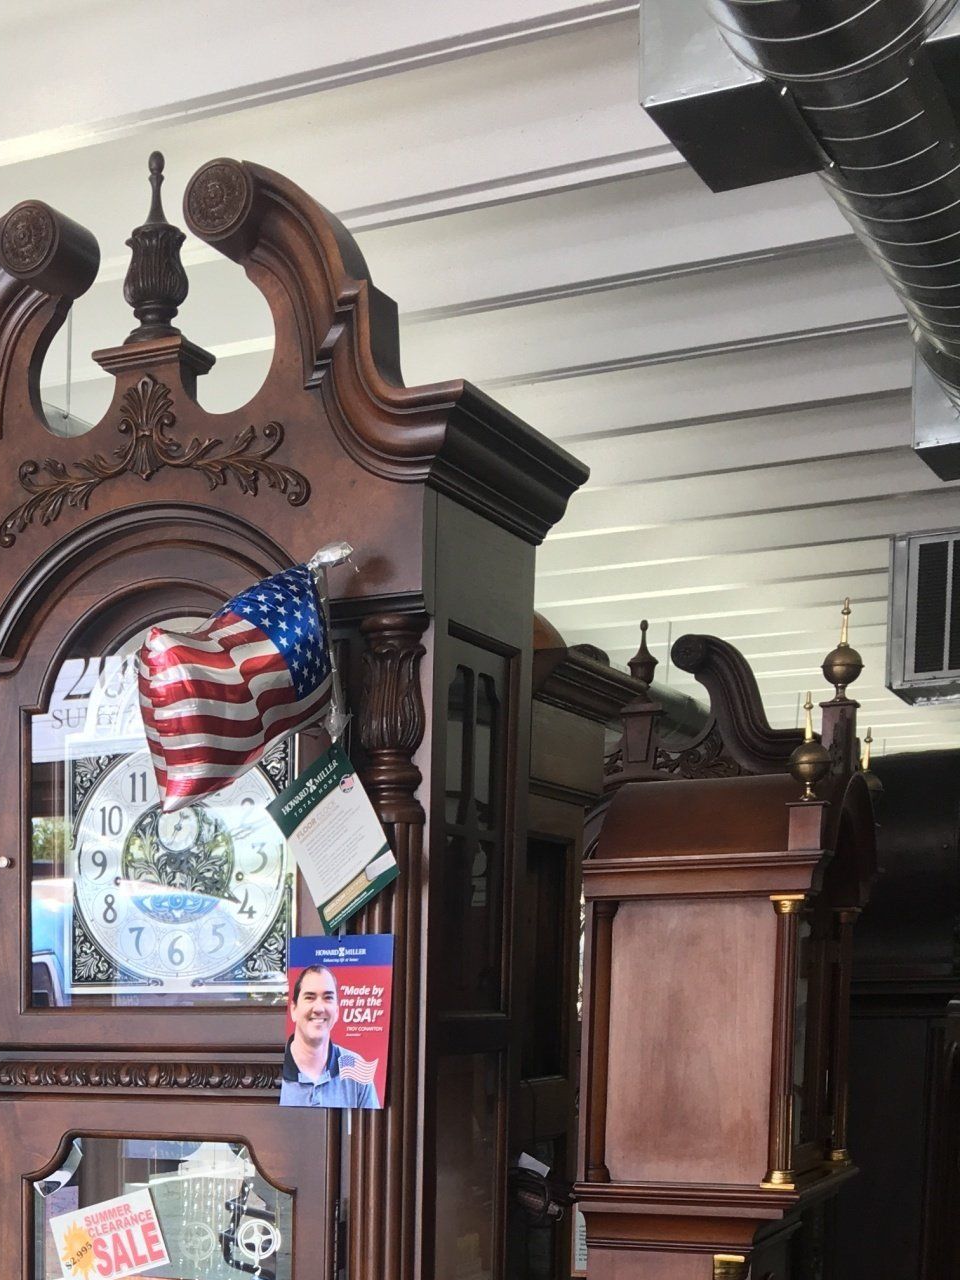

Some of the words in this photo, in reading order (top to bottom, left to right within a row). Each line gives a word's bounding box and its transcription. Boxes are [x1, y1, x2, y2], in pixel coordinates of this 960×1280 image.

[129, 771, 148, 801] 11
[281, 788, 310, 815] HOWARD
[314, 759, 339, 786] MILLER
[294, 796, 316, 818] TOTAL
[319, 773, 338, 794] HOME
[100, 805, 123, 836] 10
[91, 850, 107, 880] 9
[250, 843, 268, 874] 3
[103, 894, 117, 924] 8
[237, 888, 257, 919] 4
[128, 926, 146, 957] 7
[168, 935, 185, 966] 6
[208, 923, 226, 954] 5
[340, 985, 370, 996] "Made
[372, 985, 384, 997] by
[340, 999, 354, 1007] me
[356, 997, 365, 1007] in
[366, 997, 382, 1007] the
[342, 1008, 384, 1023] USA!"
[84, 1203, 132, 1227] SUMMER
[88, 1209, 154, 1238] CLEARANCE
[65, 1241, 93, 1270] $2,995
[93, 1221, 165, 1277] SALE
